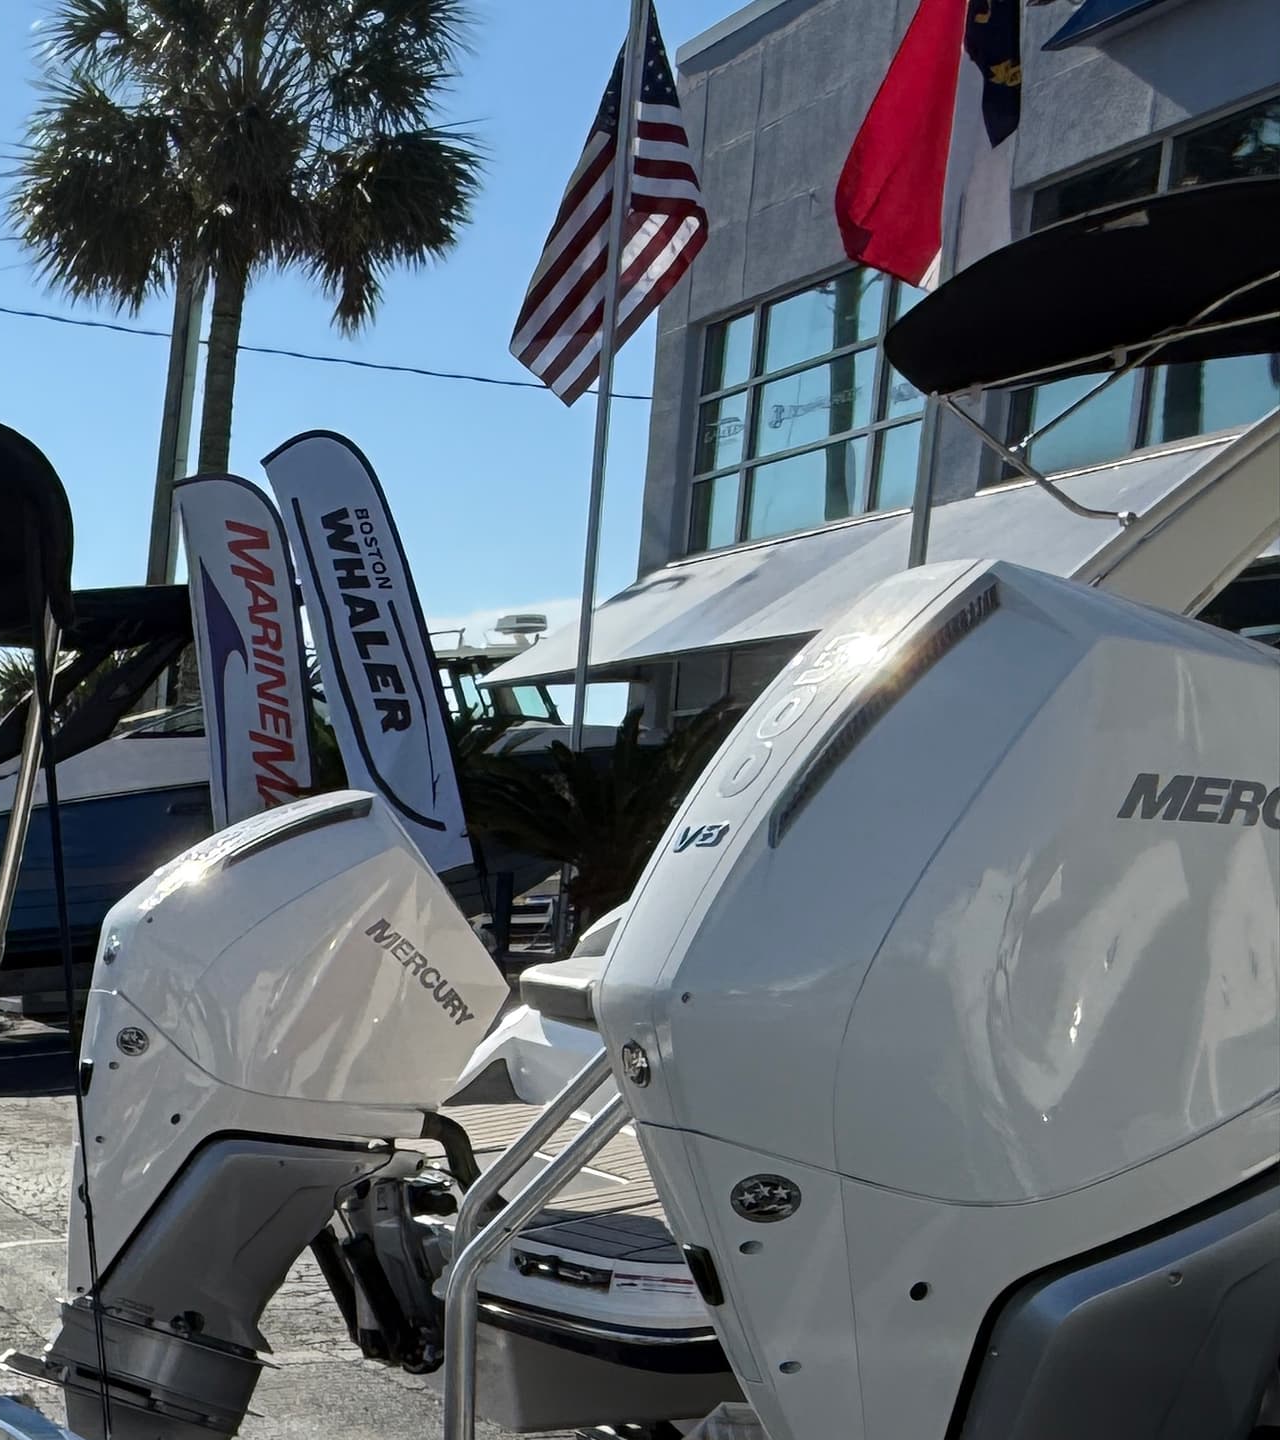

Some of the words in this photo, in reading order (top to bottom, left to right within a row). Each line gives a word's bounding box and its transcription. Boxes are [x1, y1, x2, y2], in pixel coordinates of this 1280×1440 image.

[355, 508, 392, 589] BOSTON
[321, 507, 412, 734] WHALER
[365, 918, 475, 1025] MERCURY
